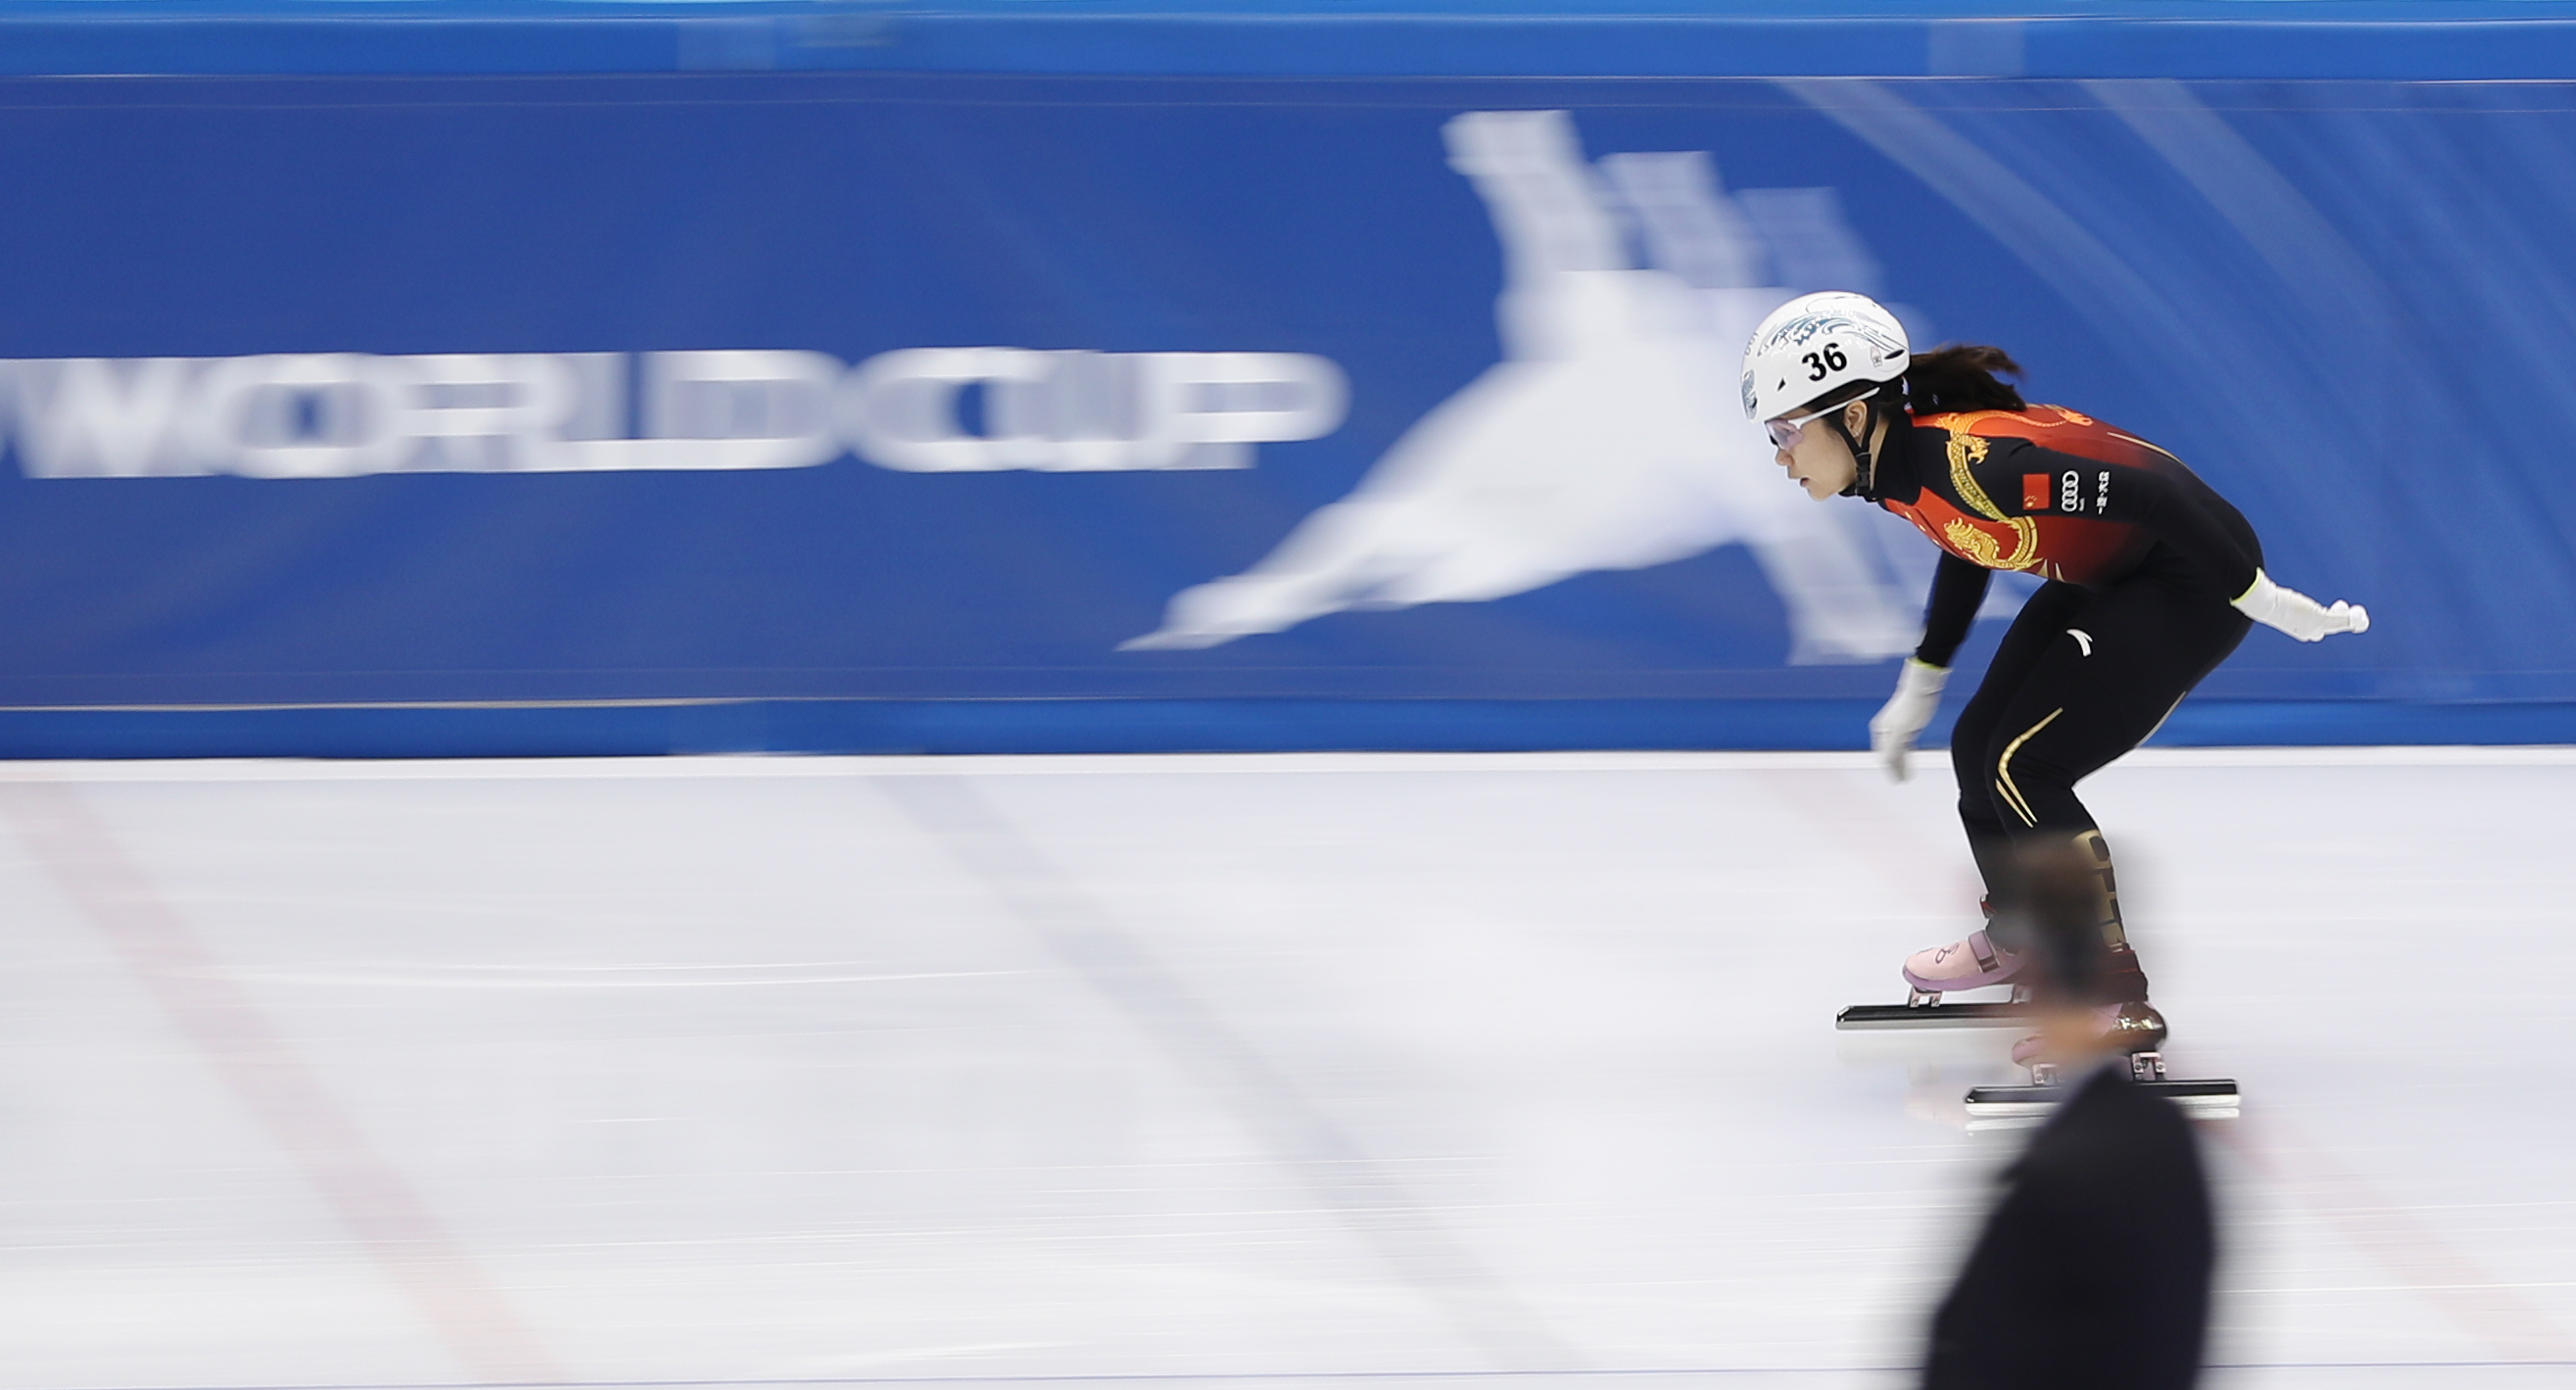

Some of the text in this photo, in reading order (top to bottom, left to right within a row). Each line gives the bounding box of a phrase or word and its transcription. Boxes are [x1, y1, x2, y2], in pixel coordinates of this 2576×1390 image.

[1802, 343, 1847, 381] 36
[0, 346, 1347, 479] WORLD CUP
